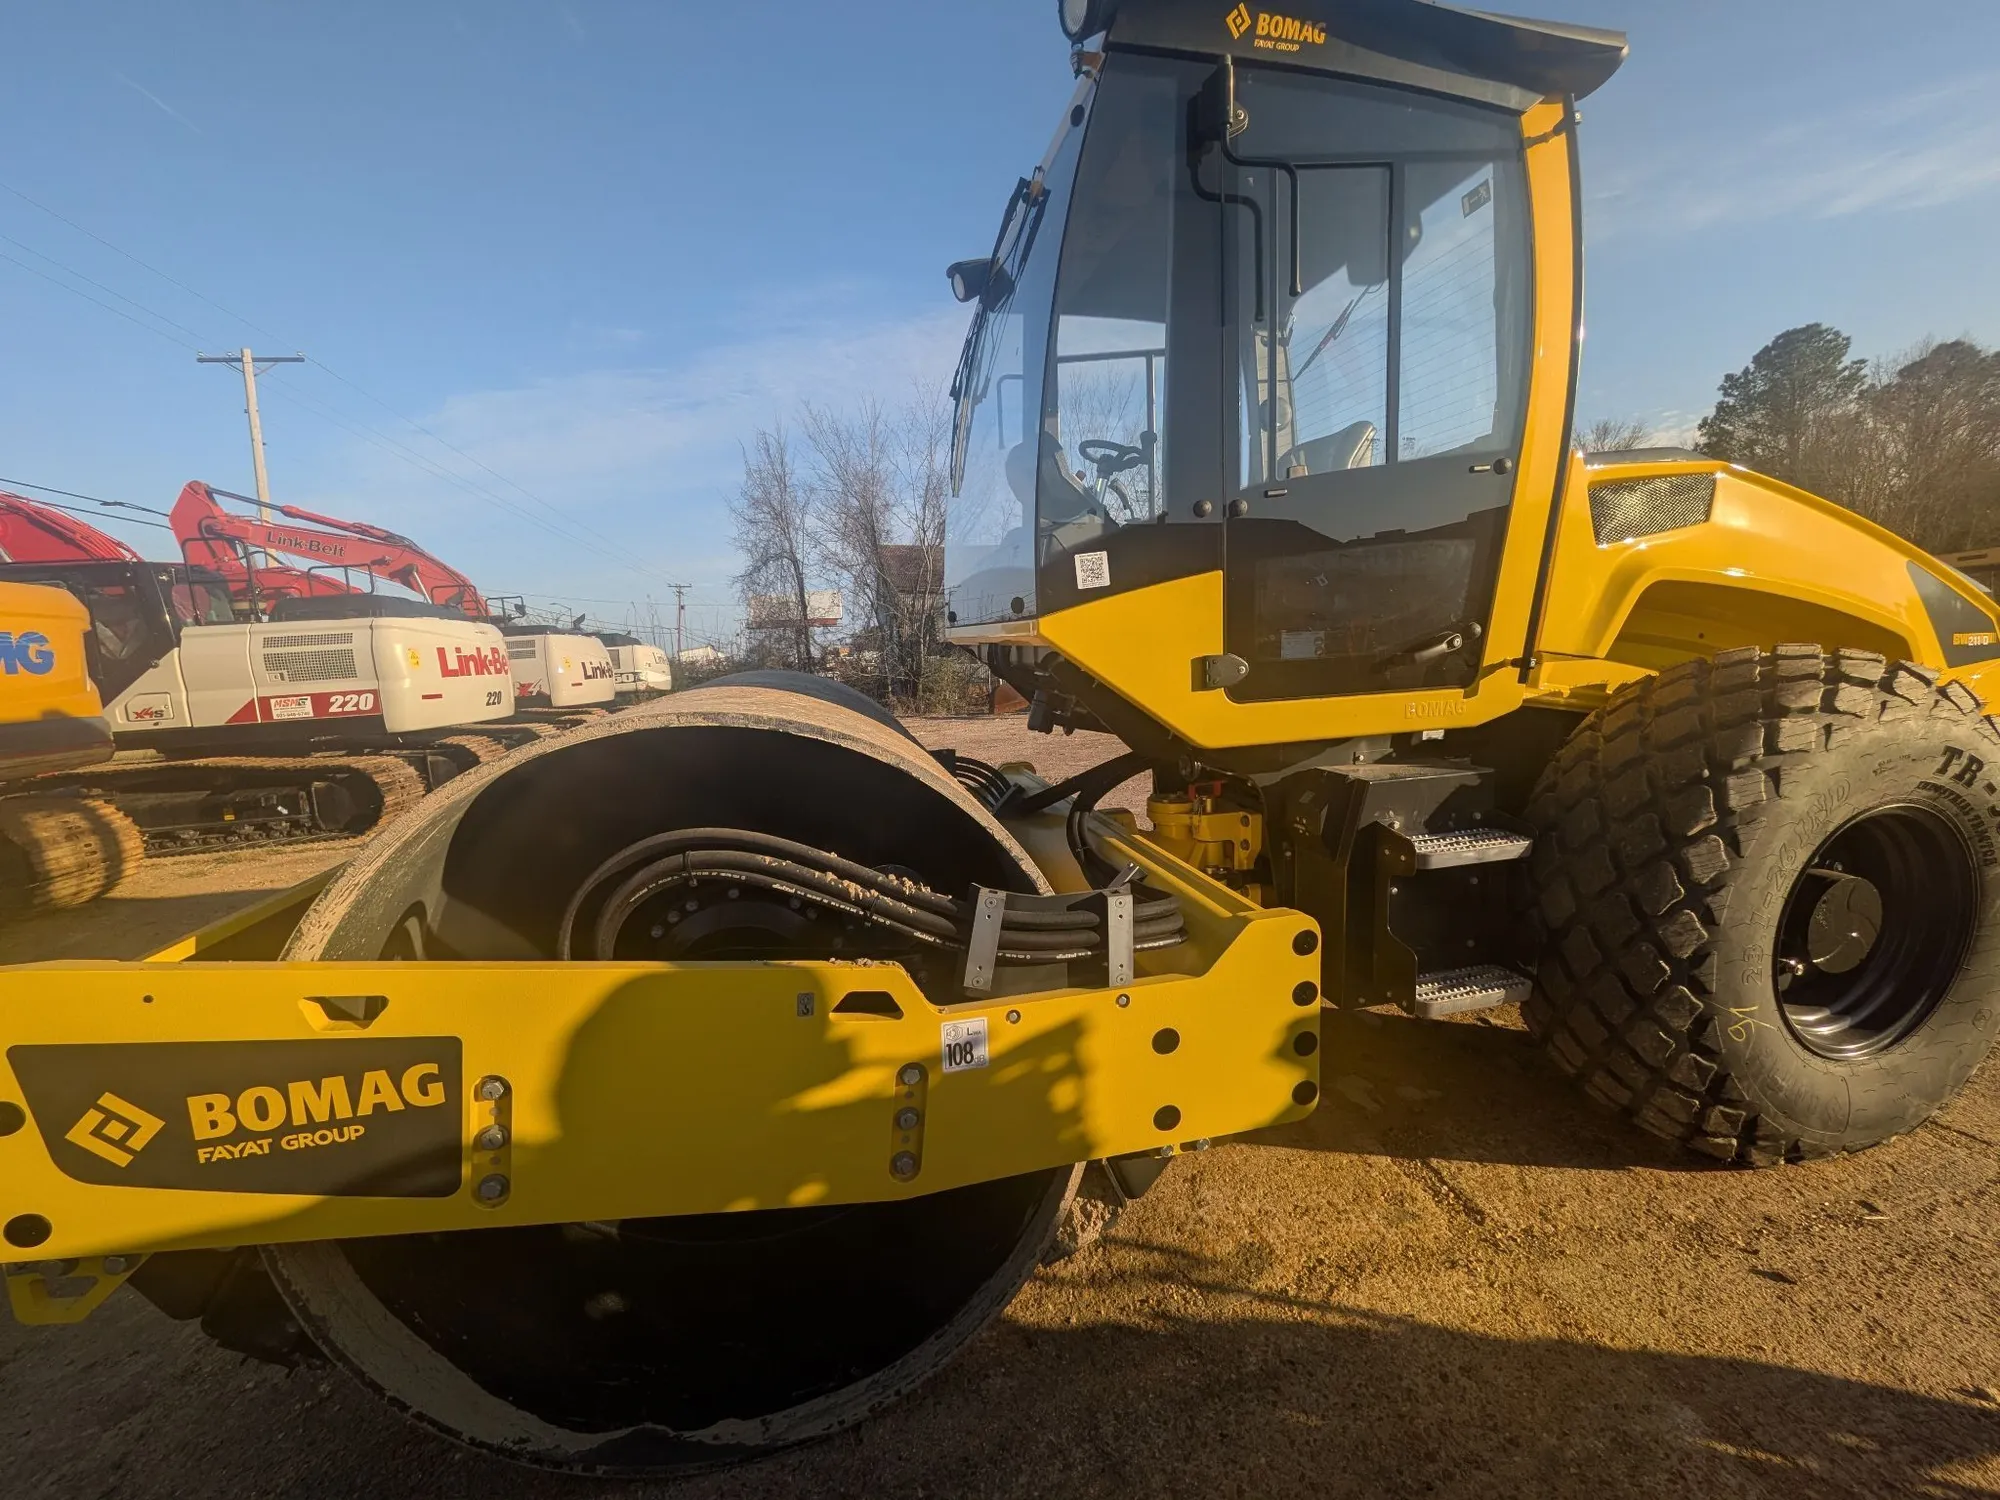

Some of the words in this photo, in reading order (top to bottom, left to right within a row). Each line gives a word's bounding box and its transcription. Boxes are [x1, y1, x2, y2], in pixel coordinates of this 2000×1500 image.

[1256, 13, 1326, 44] BOMAG
[1254, 39, 1275, 49] FAYAT
[1276, 42, 1300, 52] GROUP
[267, 531, 345, 556] Link-Belt
[328, 693, 374, 713] 220
[486, 691, 502, 706] 220
[1404, 699, 1467, 719] BOMAG
[946, 1041, 974, 1067] 108
[187, 1063, 446, 1140] BOMAG
[197, 1137, 273, 1164] FAYAT
[281, 1125, 365, 1151] GROUP
